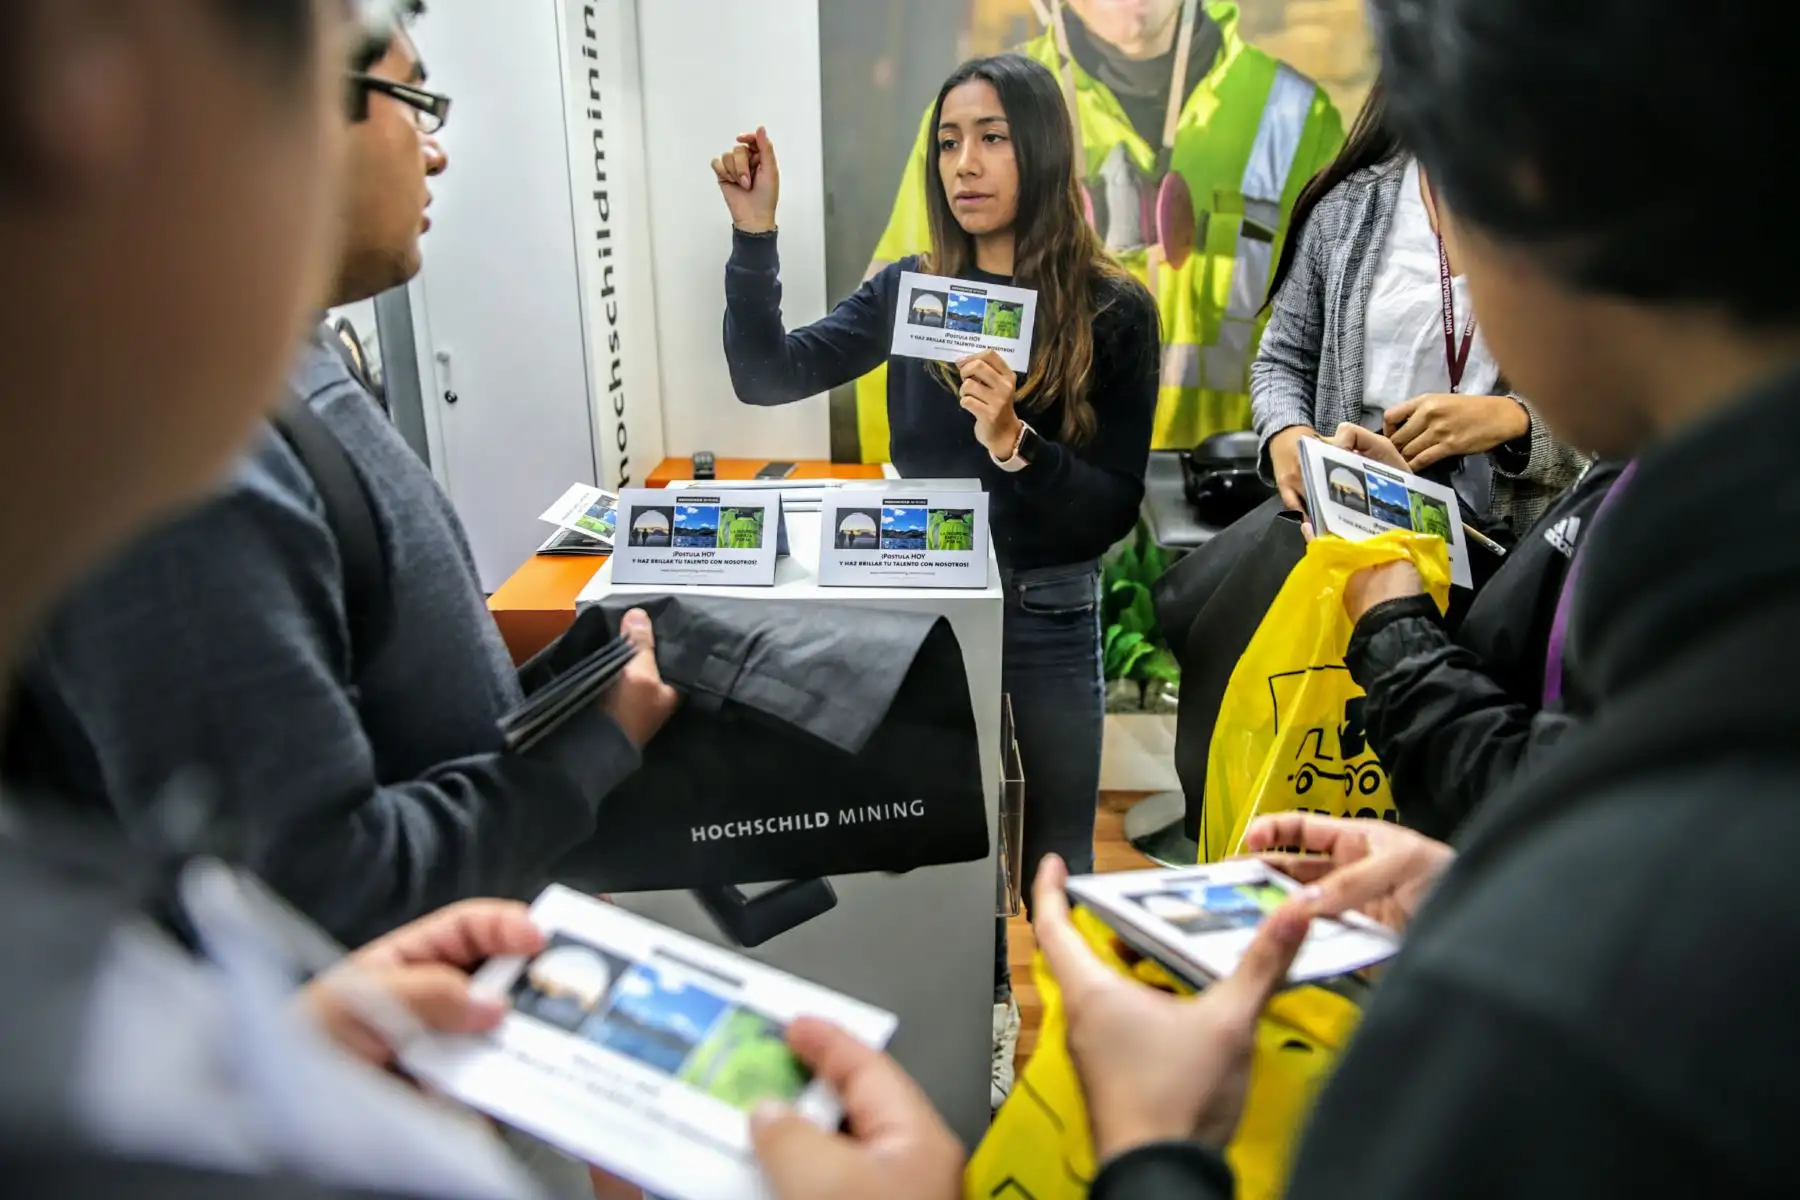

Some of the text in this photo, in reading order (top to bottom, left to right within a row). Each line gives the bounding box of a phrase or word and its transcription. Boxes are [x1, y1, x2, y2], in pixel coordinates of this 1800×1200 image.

[582, 0, 630, 493] hochschildminin
[1442, 278, 1453, 335] UNIVERSIDAD
[954, 340, 975, 348] TALENTO
[690, 799, 925, 842] HOCHSCHILD MINING
